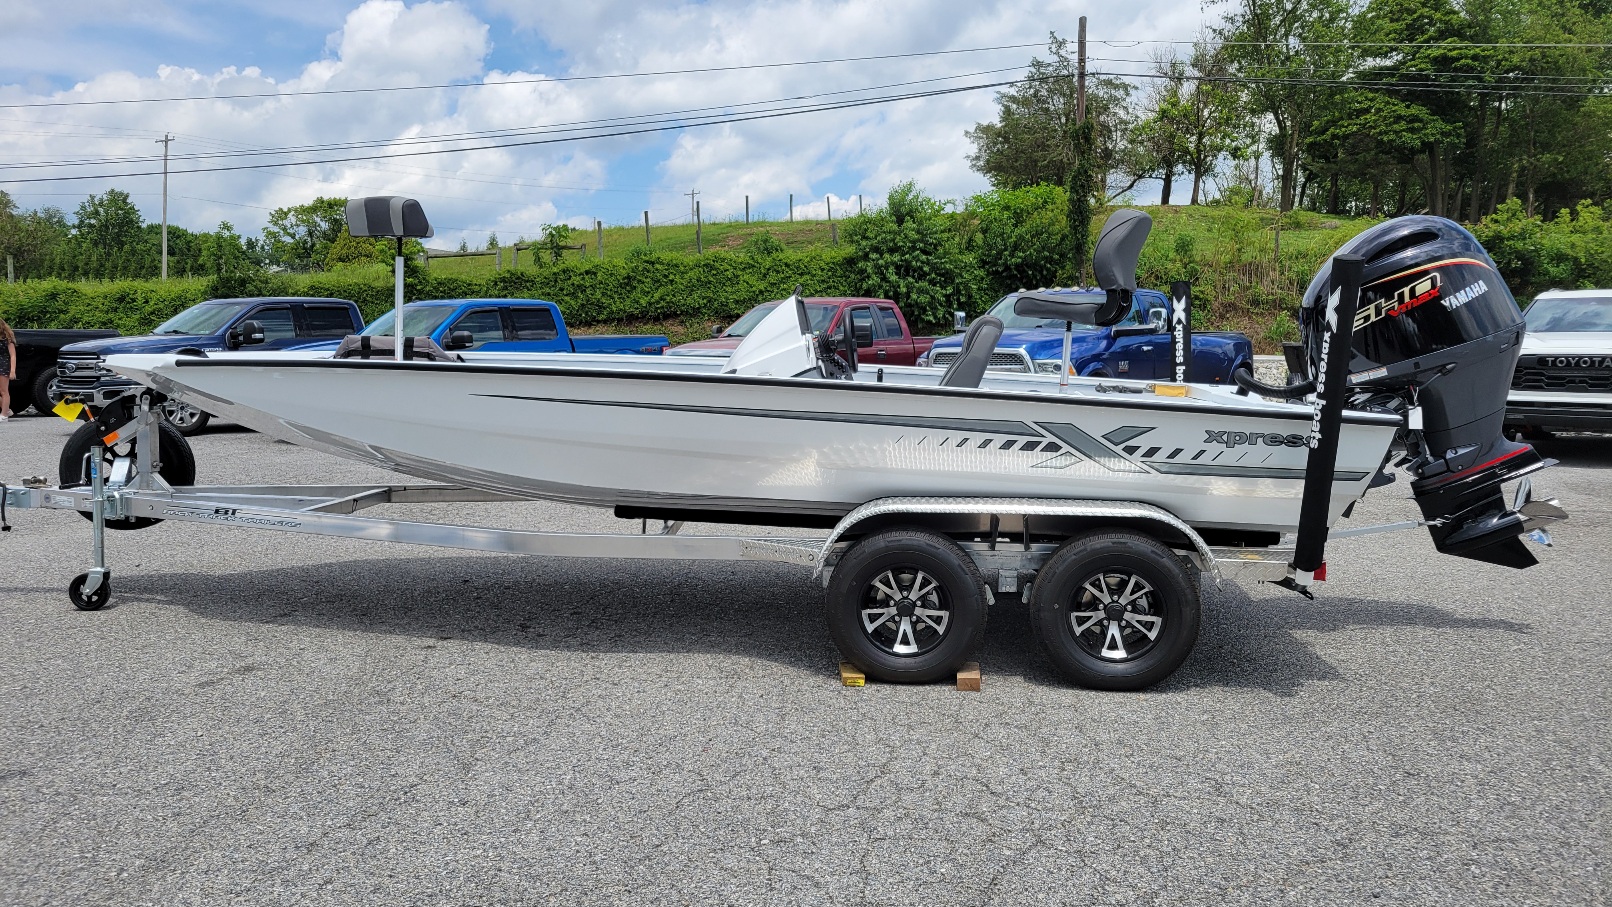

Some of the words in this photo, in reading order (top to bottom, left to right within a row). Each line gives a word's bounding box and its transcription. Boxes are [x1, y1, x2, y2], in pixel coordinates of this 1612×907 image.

[1441, 280, 1489, 312] YAMAHA
[1174, 323, 1184, 364] xpress
[1546, 357, 1612, 368] TOYOTA
[1310, 398, 1327, 449] boats
